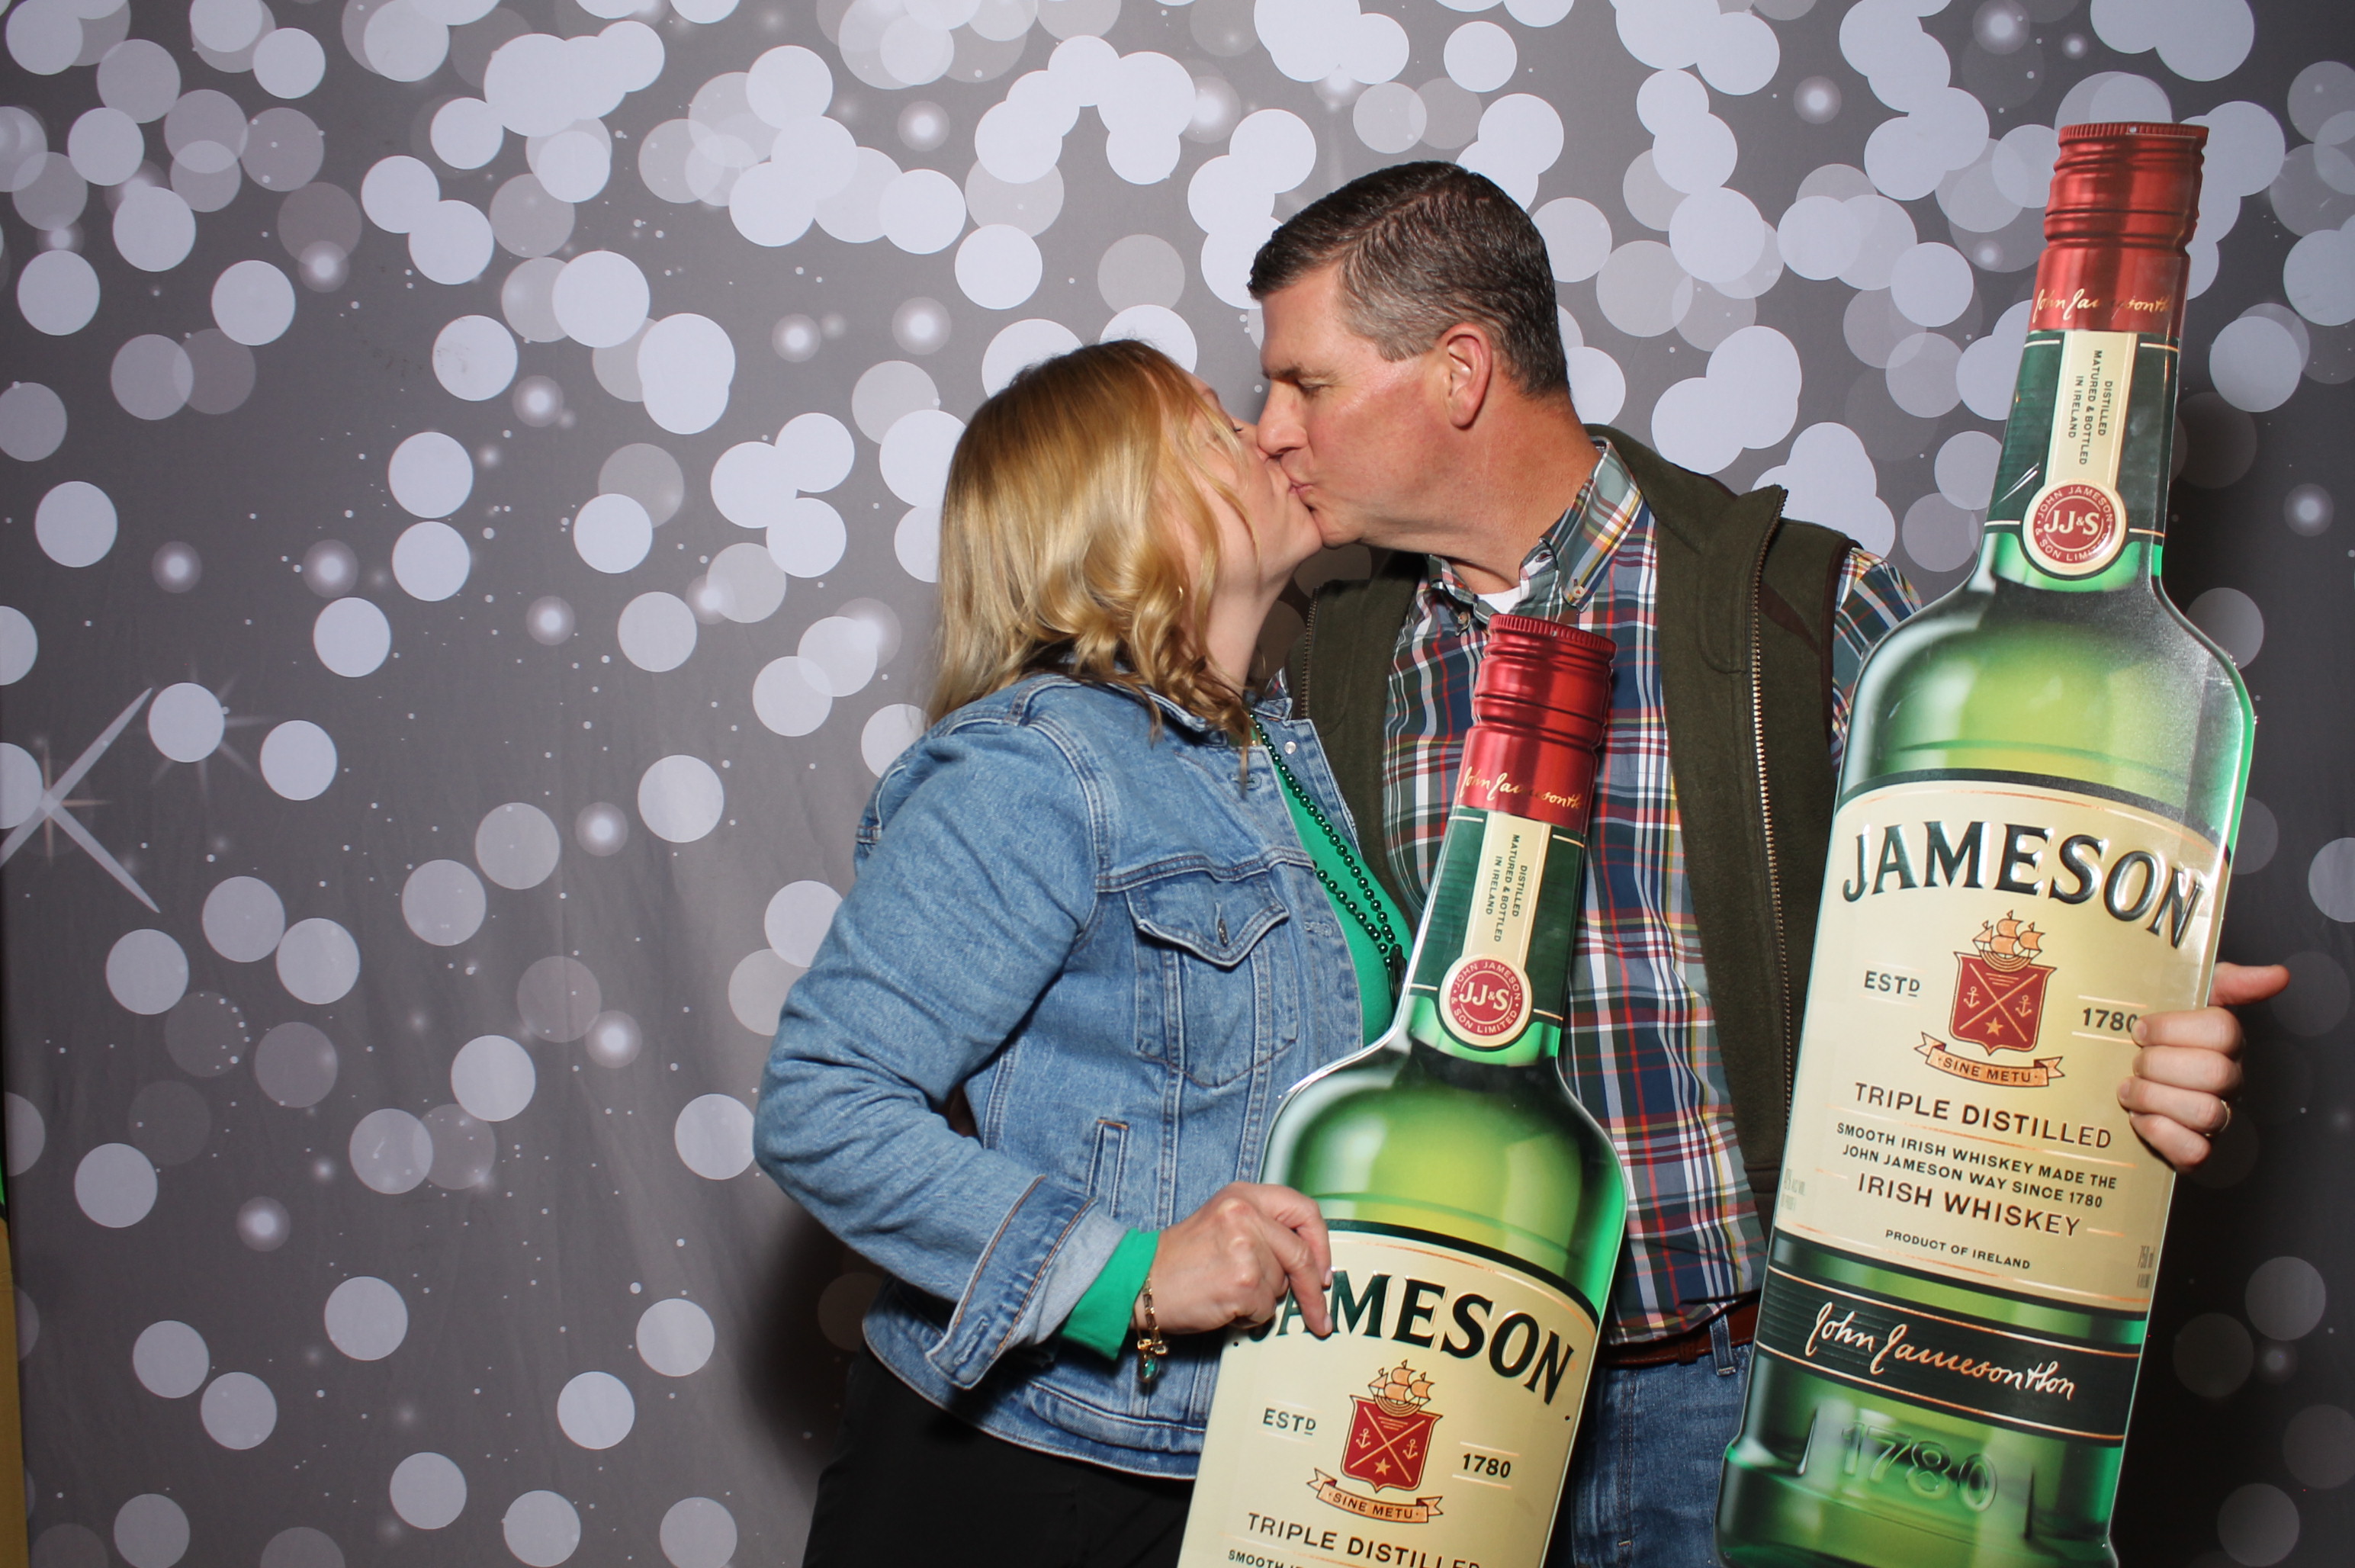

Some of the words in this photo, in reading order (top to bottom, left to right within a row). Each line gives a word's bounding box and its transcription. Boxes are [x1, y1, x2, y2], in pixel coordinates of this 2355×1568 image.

[2075, 375, 2084, 386] IN
[2087, 350, 2103, 402] MATURED
[2068, 390, 2083, 439] IRELAND
[2097, 381, 2113, 436] DISTILLED
[2079, 416, 2093, 464] BOTTLED
[2038, 490, 2062, 519] JOHN
[2068, 486, 2113, 522] JAMESON
[2043, 509, 2100, 535] JJ&S
[2039, 538, 2061, 559] SON
[1494, 856, 1502, 866] IN
[1505, 834, 1520, 883] MATURED
[1486, 869, 1500, 915] IRELAND
[1512, 864, 1528, 917] DISTILLED
[1843, 820, 2206, 949] JAMESON
[1494, 895, 1509, 942] BOTTLED
[1454, 963, 1478, 988] JOHN
[1483, 961, 1521, 1001] JAMESON
[1458, 982, 1510, 1011] JJ&S
[1454, 1008, 1473, 1029] SON
[1476, 1010, 1518, 1034] LIMITED
[1942, 1056, 1980, 1077] SINE
[1986, 1069, 2032, 1083] METU
[1855, 1081, 1951, 1120] TRIPLE
[1961, 1104, 2112, 1149] DISTILLED
[1836, 1122, 1896, 1145] SMOOTH
[1901, 1137, 1945, 1157] IRISH
[1952, 1148, 2034, 1174] WHISKEY
[2038, 1165, 2084, 1184] MADE
[2090, 1174, 2116, 1189] THE
[1843, 1144, 1879, 1162] JOHN
[1883, 1154, 1962, 1181] JAMESON
[1969, 1171, 2007, 1190] WAY
[2012, 1181, 2064, 1201] SINCE
[2069, 1191, 2103, 1208] 1780
[1858, 1172, 1933, 1207] IRISH
[1944, 1190, 2080, 1236] WHISKEY
[1885, 1229, 1946, 1252] PRODUCT
[1951, 1245, 1968, 1256] OF
[1972, 1248, 2031, 1270] IRELAND
[1461, 1452, 1512, 1479] 1780
[1842, 1421, 1997, 1512] 1780
[1333, 1492, 1367, 1512] SINE
[1372, 1505, 1413, 1519] METU
[1248, 1512, 1338, 1550] TRIPLE
